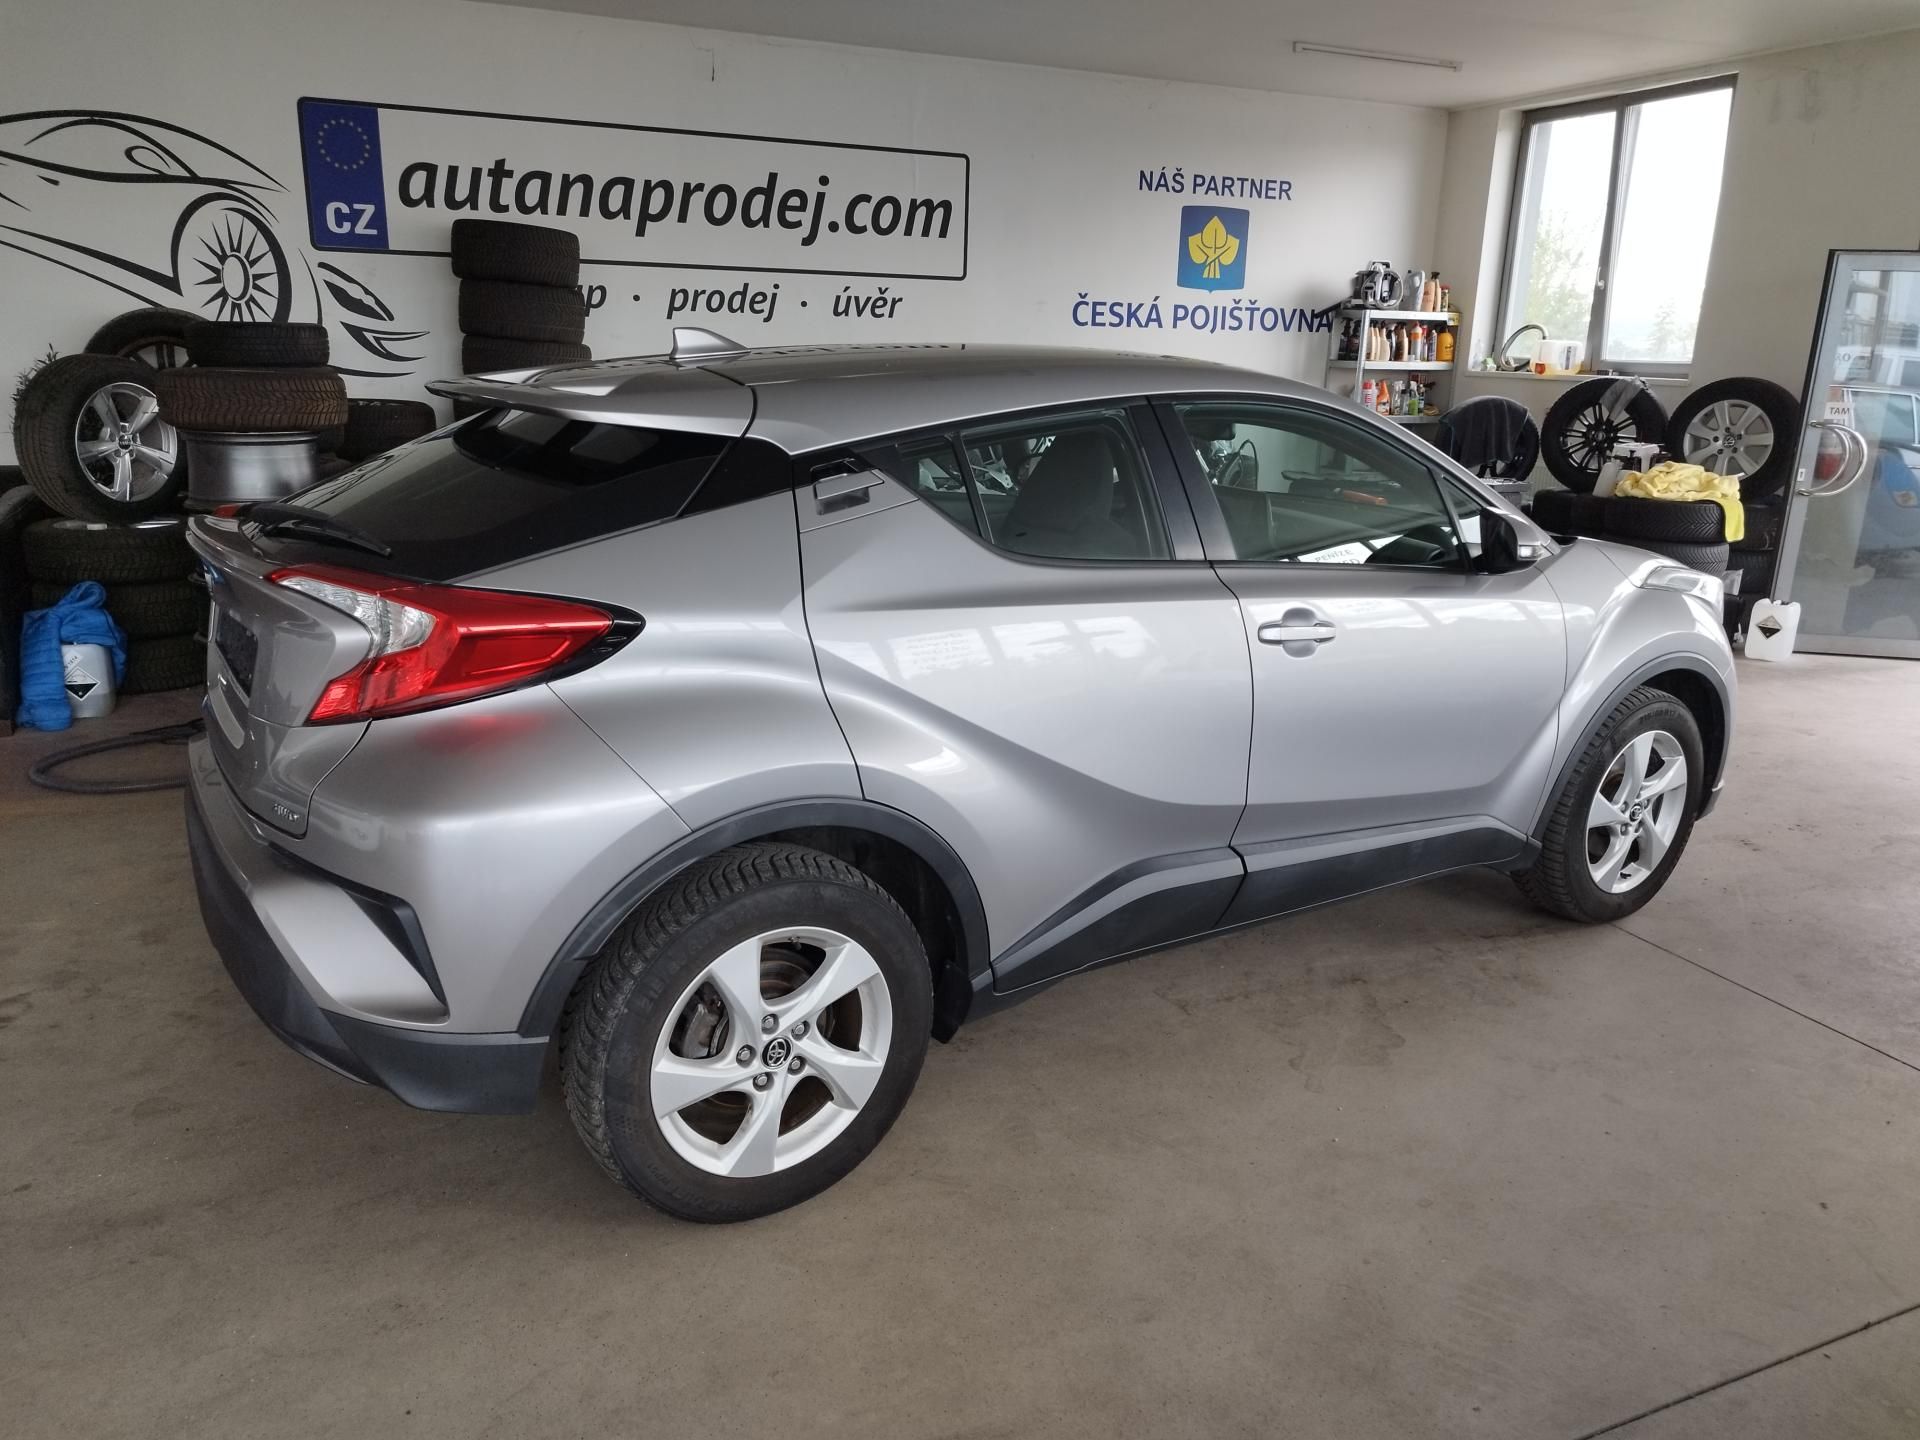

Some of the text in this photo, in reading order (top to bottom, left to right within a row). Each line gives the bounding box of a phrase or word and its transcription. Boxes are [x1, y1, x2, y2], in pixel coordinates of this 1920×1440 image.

[1139, 166, 1292, 200] NÁŠ PARTNER
[326, 201, 378, 235] CZ
[398, 157, 953, 247] autanaprodej.com
[666, 283, 780, 321] prodej
[832, 285, 904, 319] úvěr
[1072, 292, 1333, 334] ČESKÁ POJIŠŤOVNA
[1829, 406, 1850, 416] TAM
